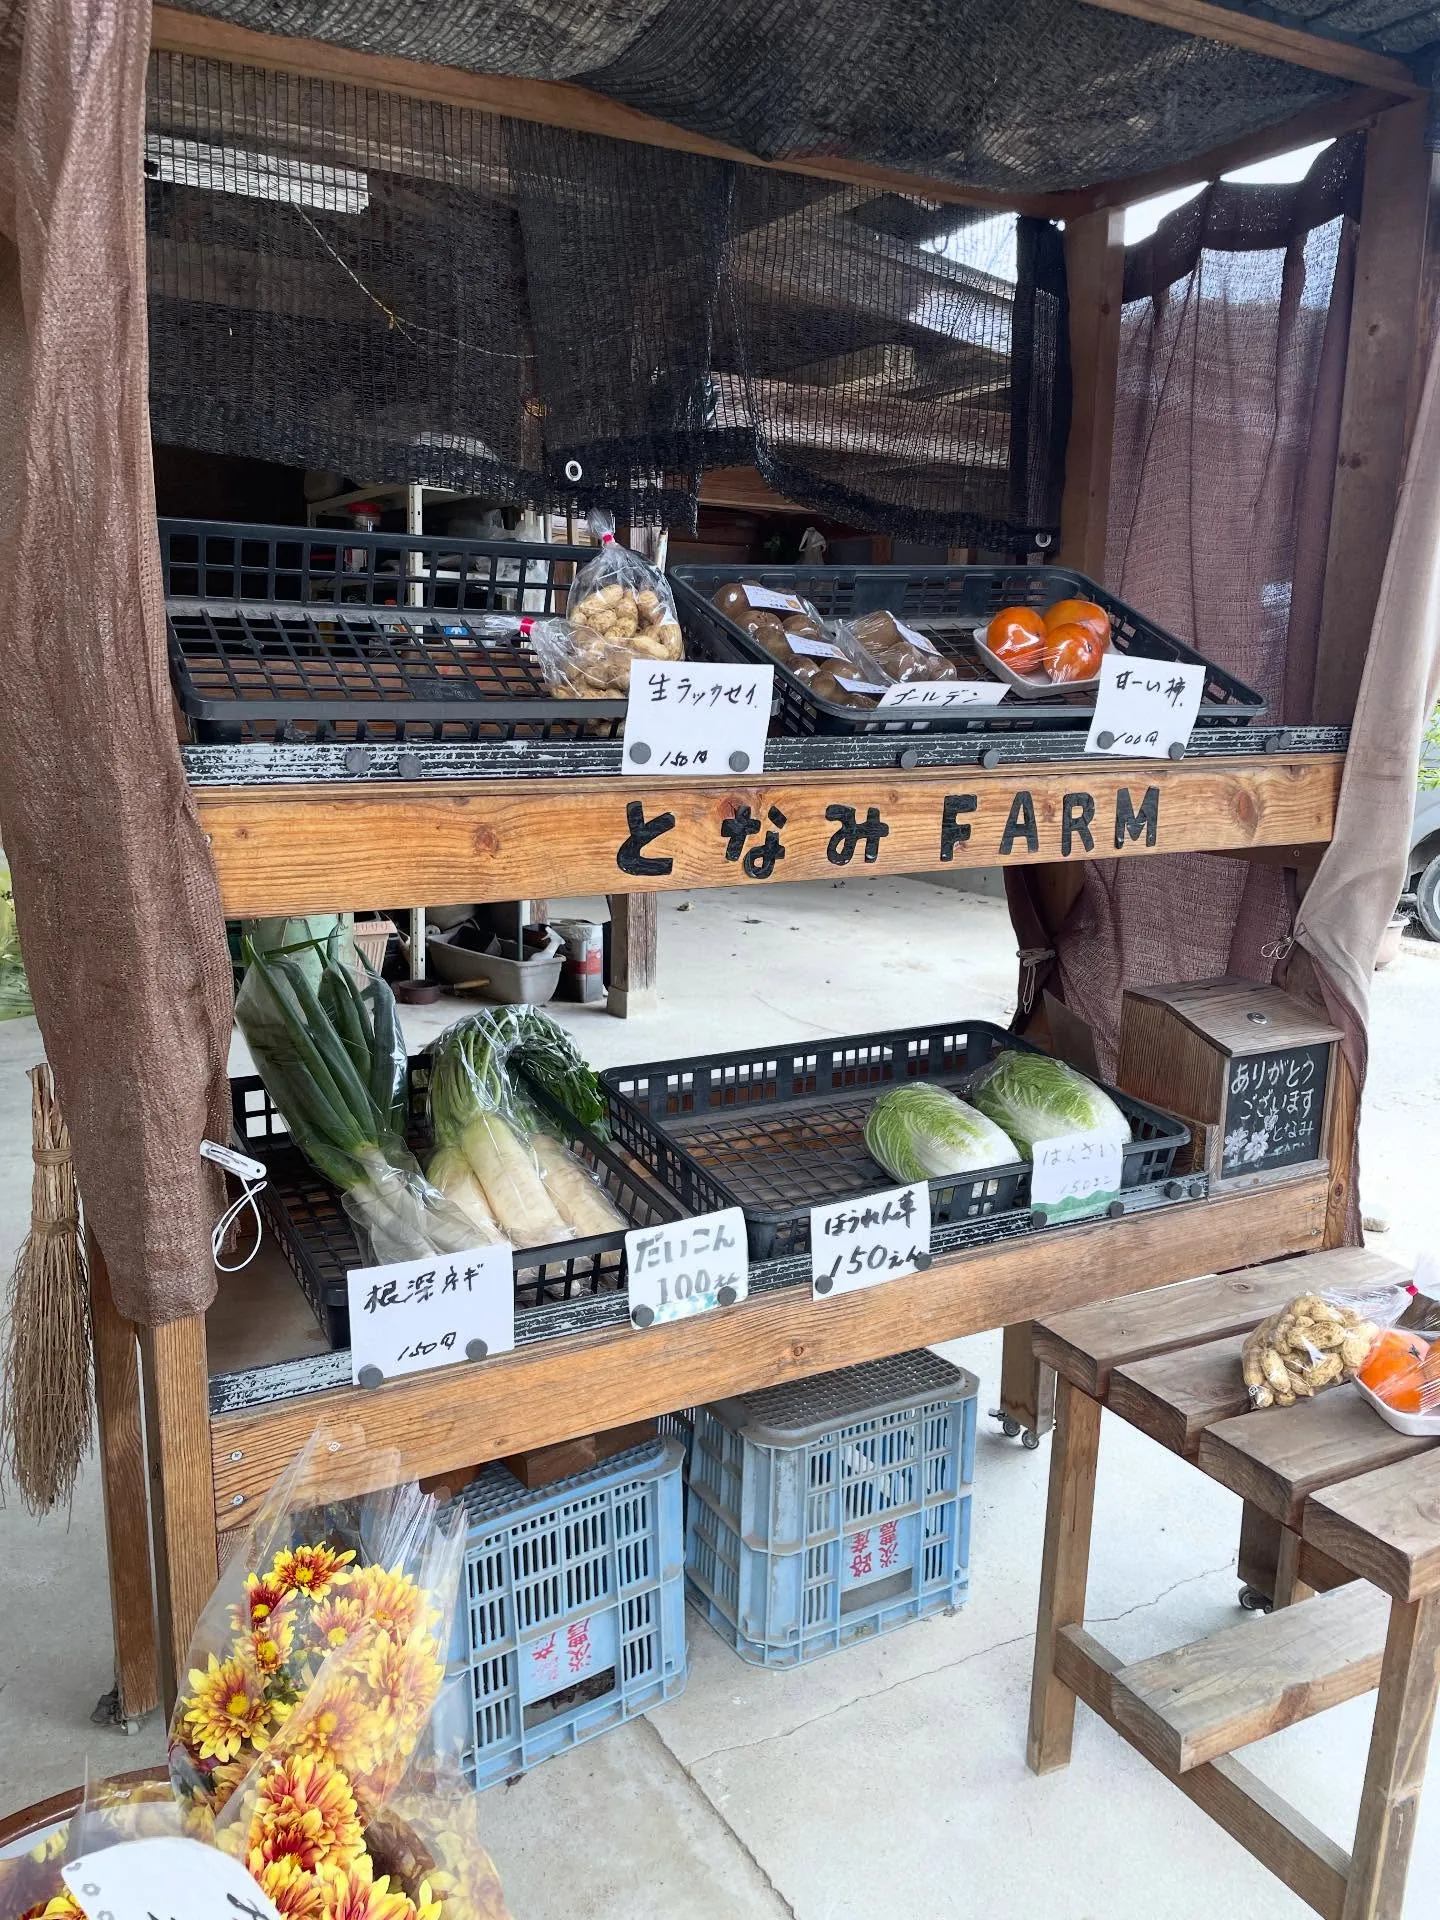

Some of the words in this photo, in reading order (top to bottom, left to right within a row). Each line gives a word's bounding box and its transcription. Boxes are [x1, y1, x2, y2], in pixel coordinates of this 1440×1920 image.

[659, 749, 709, 767] 150円
[616, 800, 890, 880] となみ
[939, 785, 1160, 862] FARM
[1230, 1053, 1315, 1095] ありがとう
[1240, 1088, 1316, 1119] ございます
[1272, 1120, 1315, 1142] となみ
[1042, 1142, 1118, 1167] はくさい
[824, 1189, 918, 1237] ほうれん草
[634, 1224, 736, 1274] だいこん
[829, 1244, 921, 1277] 150えん
[363, 1263, 485, 1314] 根深ネギ
[397, 1331, 457, 1361] 150円
